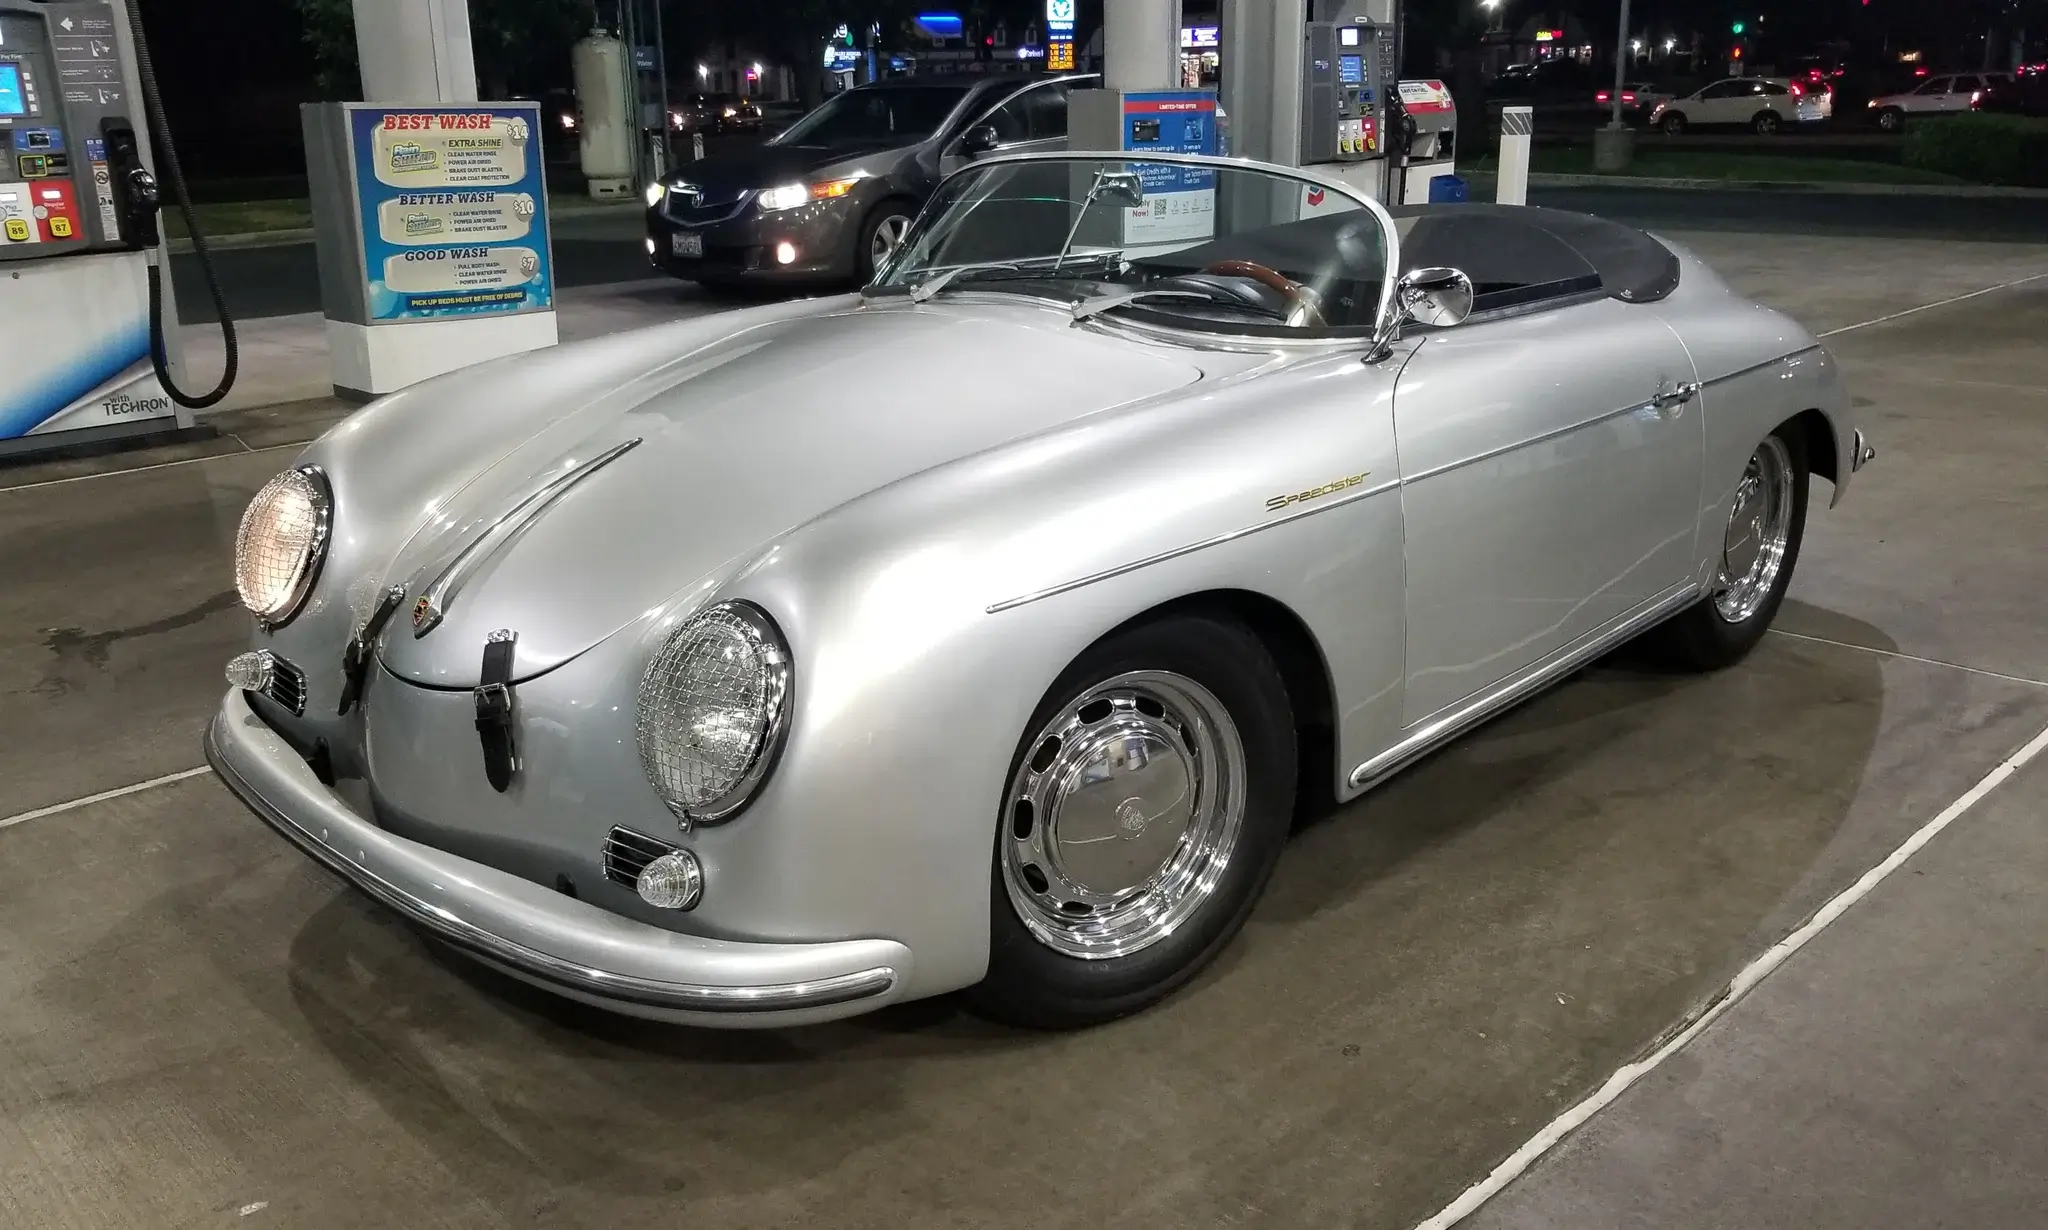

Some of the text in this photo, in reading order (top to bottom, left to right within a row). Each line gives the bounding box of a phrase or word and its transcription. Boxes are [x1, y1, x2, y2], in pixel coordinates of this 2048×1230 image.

[383, 114, 493, 130] BEST WASH
[507, 124, 530, 140] $14
[448, 138, 502, 148] EXTRA SHINE
[399, 192, 495, 206] BETTER WASH
[513, 200, 534, 215] $10
[1131, 210, 1149, 218] Now!
[11, 226, 25, 235] 89
[54, 223, 67, 232] 87
[405, 248, 488, 262] GOOD WASH
[521, 257, 536, 271] $7
[504, 291, 523, 299] DEBRIS
[109, 394, 130, 404] with
[102, 397, 168, 416] TECHRON
[1265, 471, 1372, 512] Speedster
